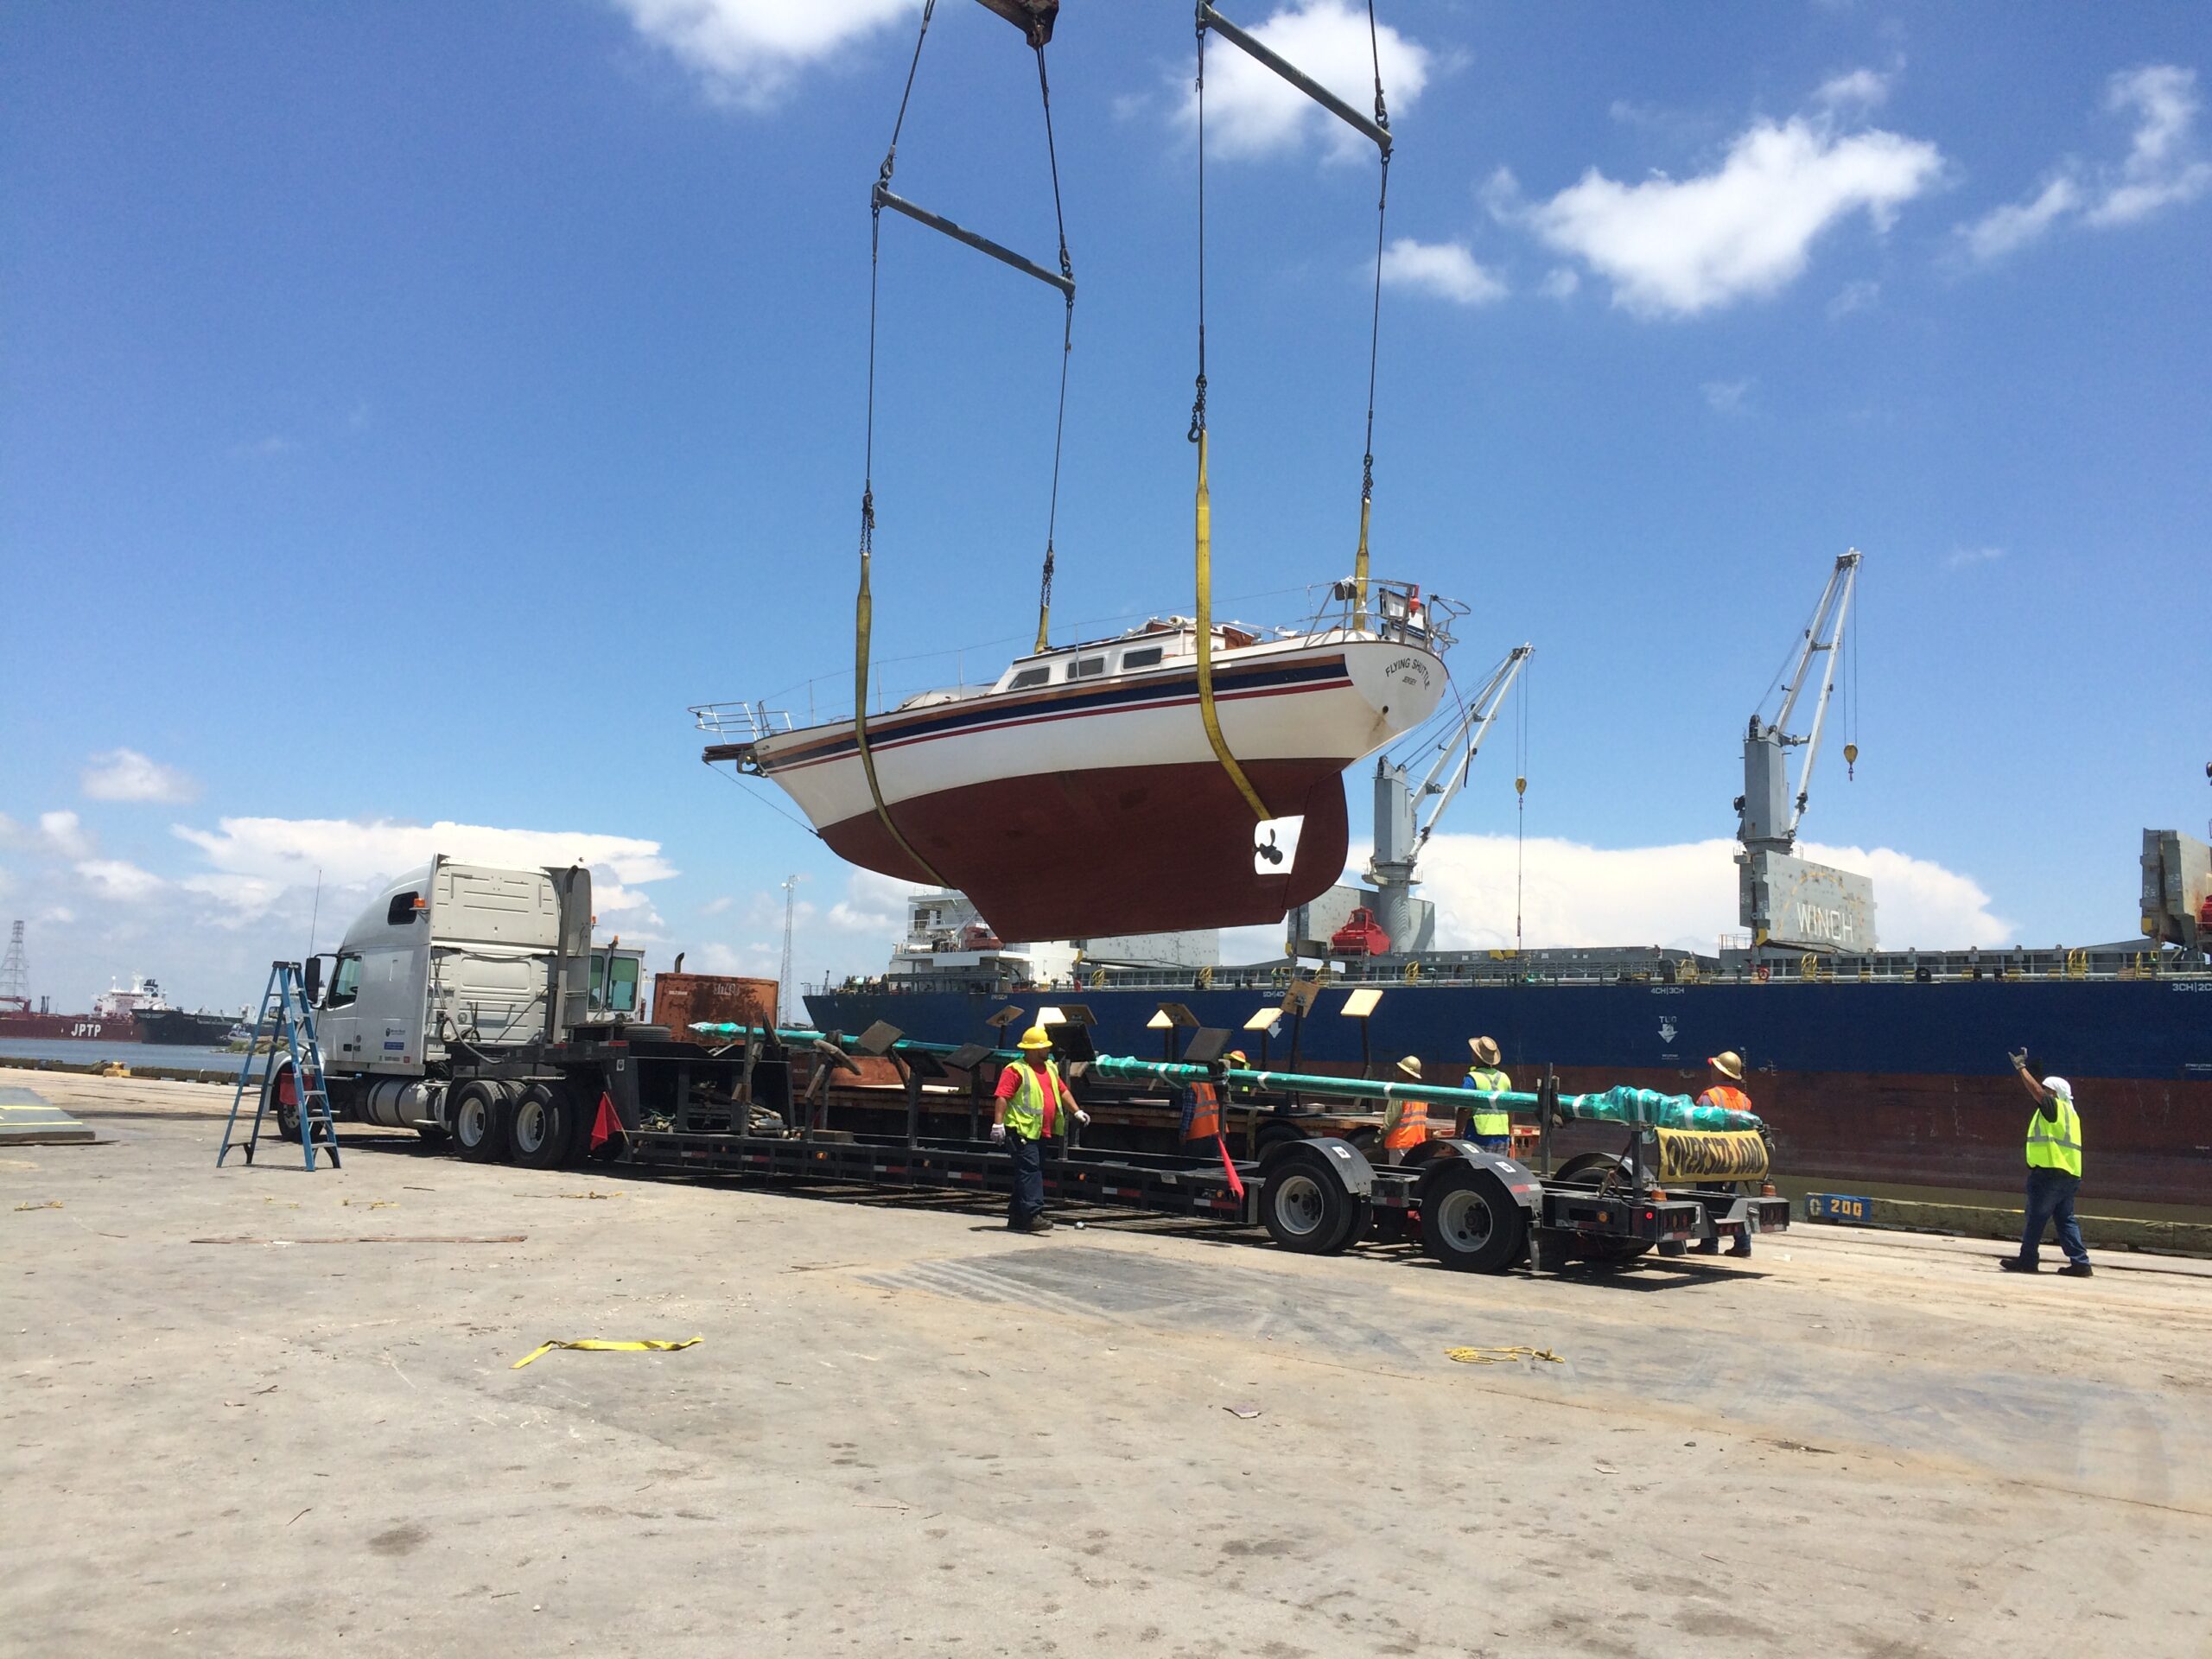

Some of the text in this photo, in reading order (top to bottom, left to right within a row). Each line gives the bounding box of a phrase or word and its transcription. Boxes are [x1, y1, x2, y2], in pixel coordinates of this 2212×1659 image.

[1385, 658, 1430, 690] FLYING SHUTTLE
[1402, 676, 1417, 685] JERSEY
[1796, 902, 1853, 943] WINCH
[71, 1023, 101, 1037] JPTP
[1666, 1135, 1765, 1177] OVERSIZE LOAD
[1830, 1198, 1863, 1217] 200
